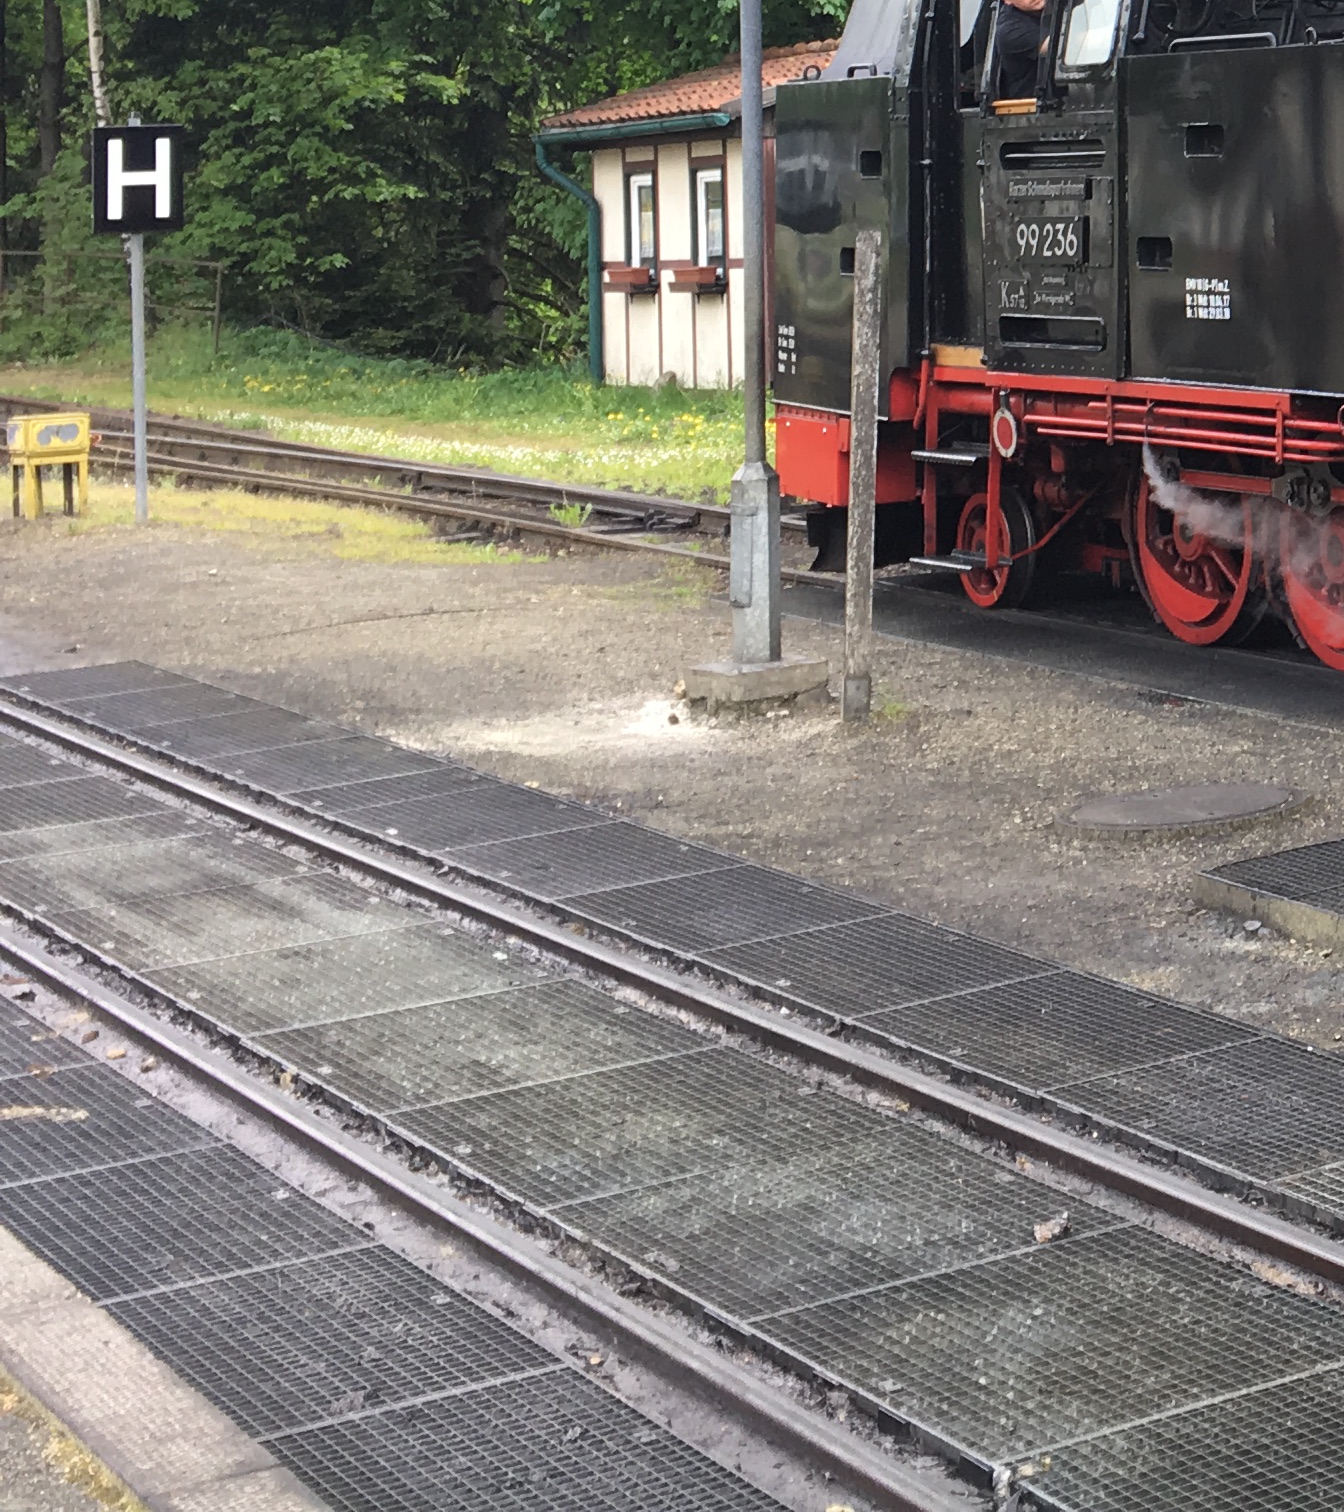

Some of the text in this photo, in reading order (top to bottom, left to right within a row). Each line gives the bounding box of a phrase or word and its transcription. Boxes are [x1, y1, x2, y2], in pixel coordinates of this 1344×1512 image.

[106, 137, 171, 221] H
[1016, 223, 1078, 257] 99 236
